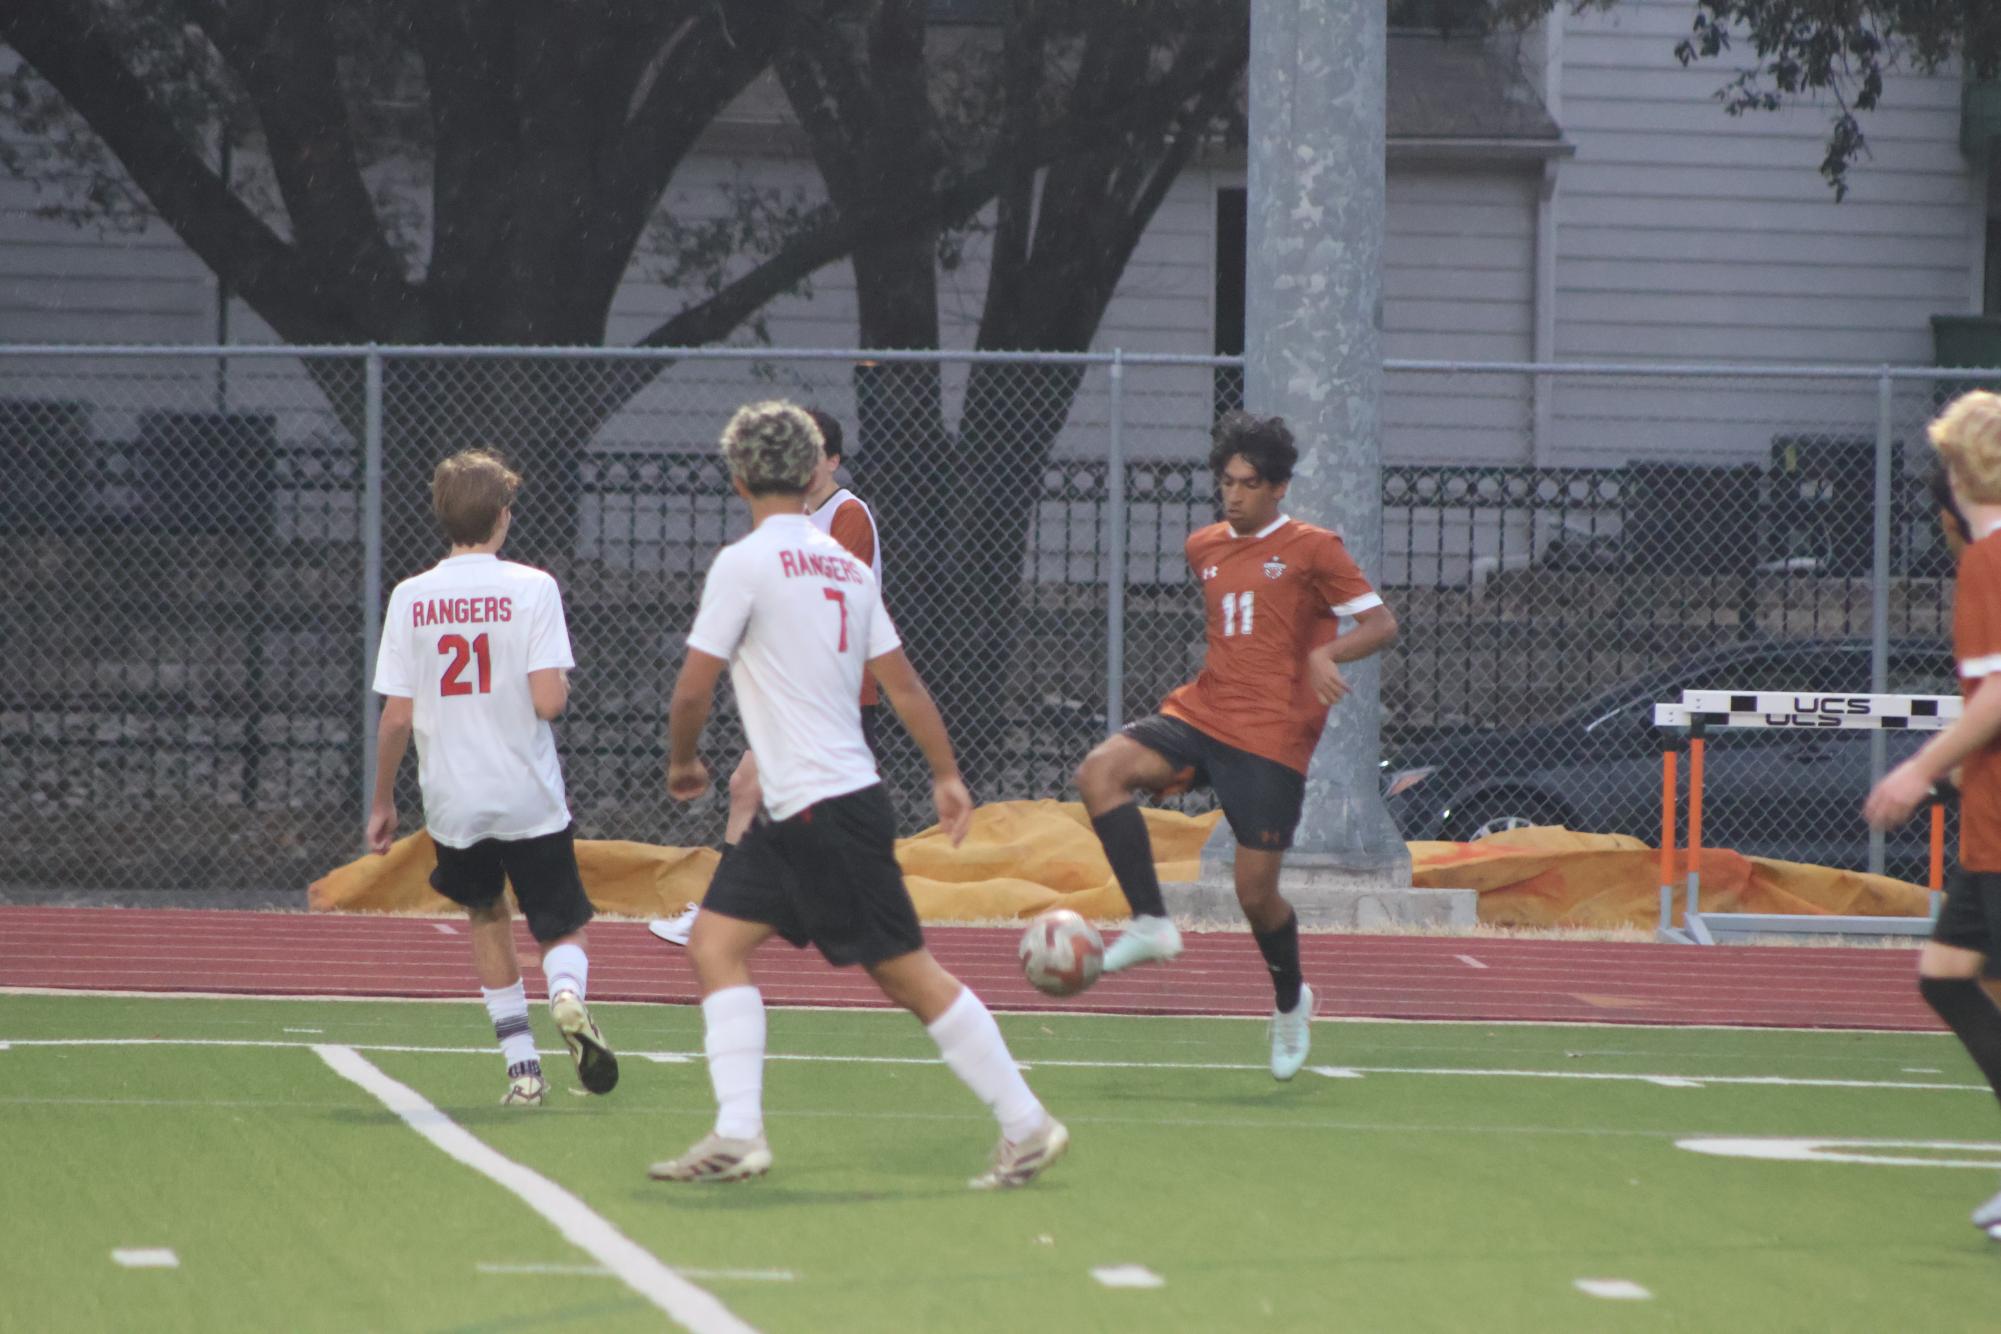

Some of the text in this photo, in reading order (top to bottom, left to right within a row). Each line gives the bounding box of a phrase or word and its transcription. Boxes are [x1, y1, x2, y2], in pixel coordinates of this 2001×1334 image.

[779, 549, 863, 585] RANGERS
[412, 597, 512, 628] RANGERS
[822, 587, 848, 653] 7
[1222, 591, 1254, 636] 11
[437, 633, 492, 697] 21
[1794, 697, 1871, 714] UCS
